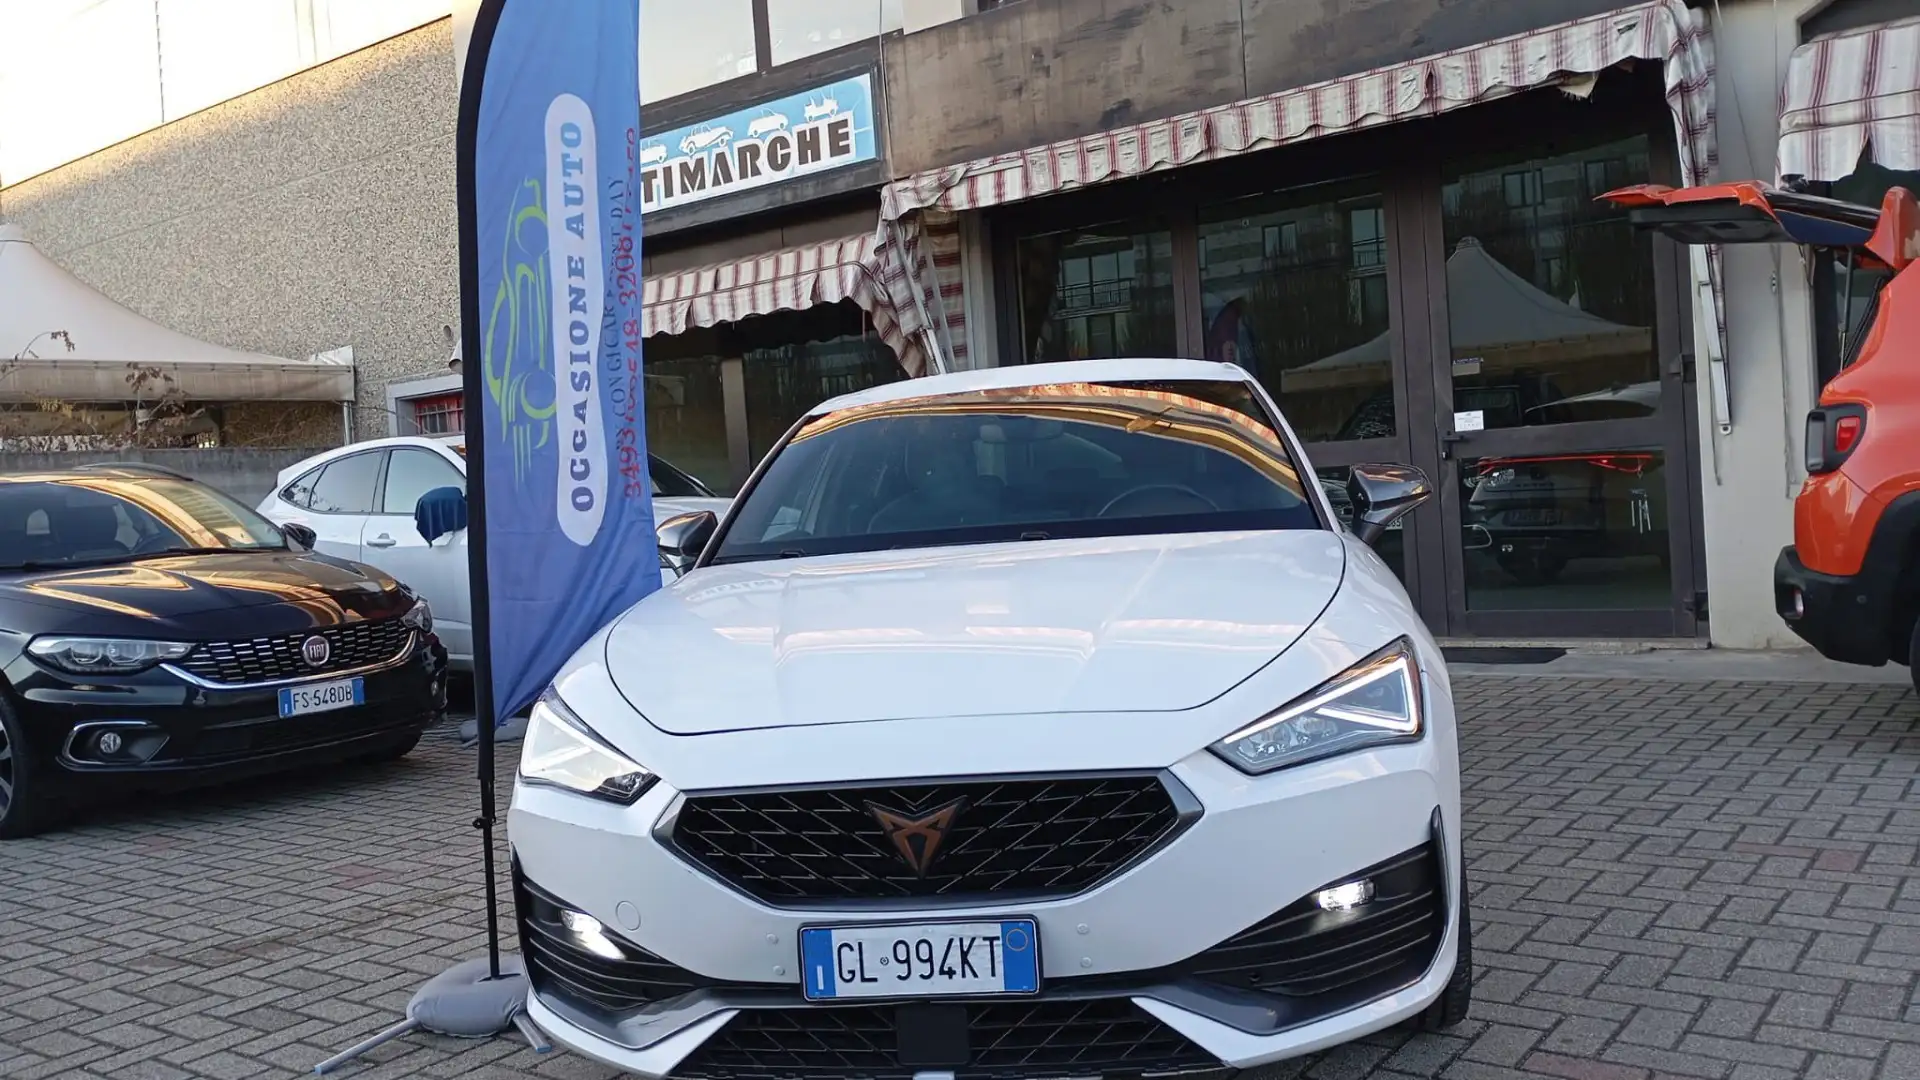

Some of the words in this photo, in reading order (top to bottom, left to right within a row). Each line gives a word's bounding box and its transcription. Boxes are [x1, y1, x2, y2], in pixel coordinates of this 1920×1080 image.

[560, 121, 585, 240] AUTO
[608, 177, 624, 219] DAY
[568, 255, 594, 512] OCCASIONE
[309, 643, 326, 660] FIAT
